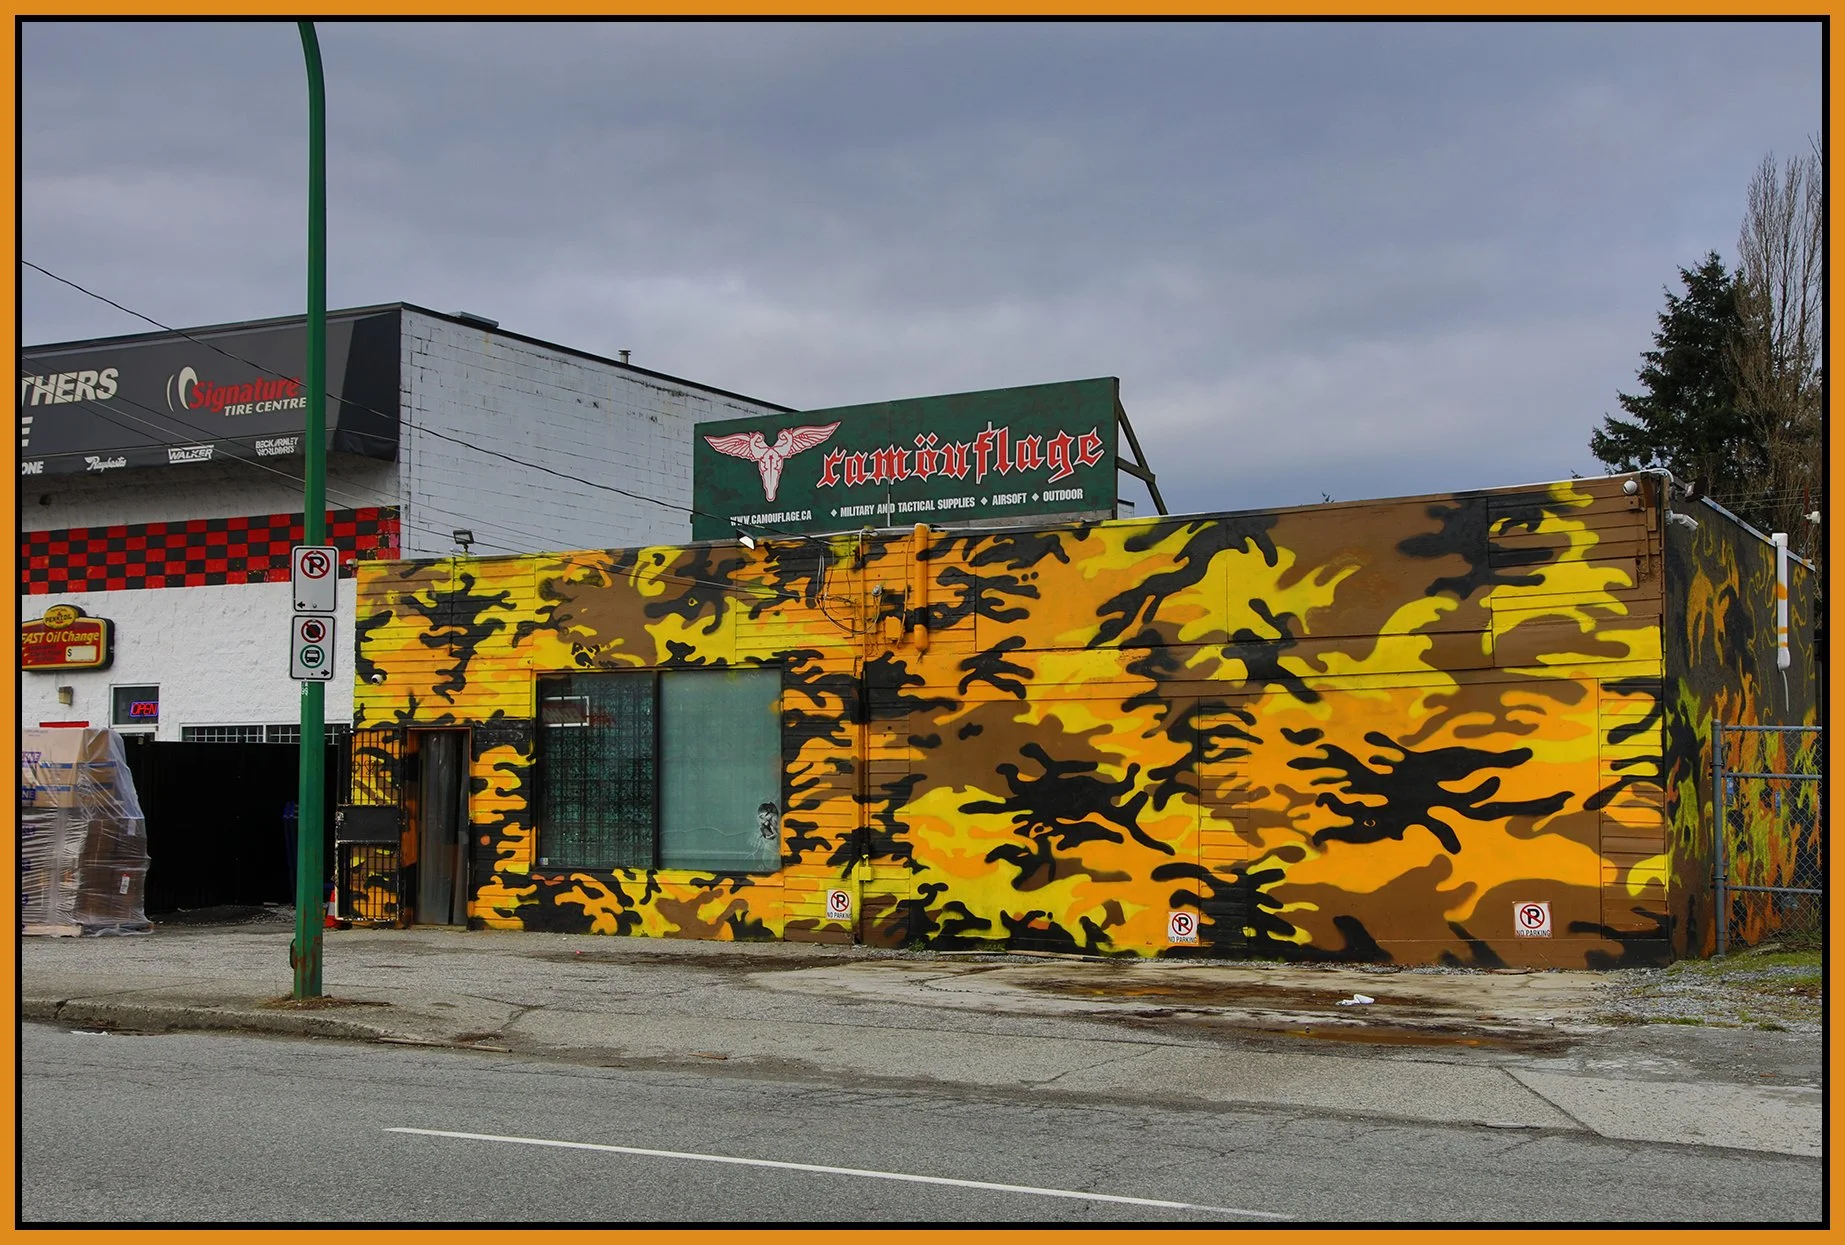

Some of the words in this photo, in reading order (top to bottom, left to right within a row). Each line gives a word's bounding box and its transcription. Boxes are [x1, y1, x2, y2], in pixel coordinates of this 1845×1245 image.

[189, 375, 301, 413] Signature
[224, 403, 253, 416] TIRE
[256, 397, 307, 412] CENTRE
[168, 445, 214, 462] WALKER
[840, 504, 874, 517] MILITARY
[877, 502, 895, 515] AND
[898, 500, 935, 513] TACTICAL
[937, 497, 975, 510] SUPPLIES
[992, 492, 1027, 506] AIRSOFT
[1043, 488, 1083, 502] OUTDOOR
[730, 510, 812, 526] WWW.CAMOUFLAGE.CA
[46, 631, 60, 643] Oil
[61, 630, 99, 645] Change
[132, 703, 158, 715] OPEN
